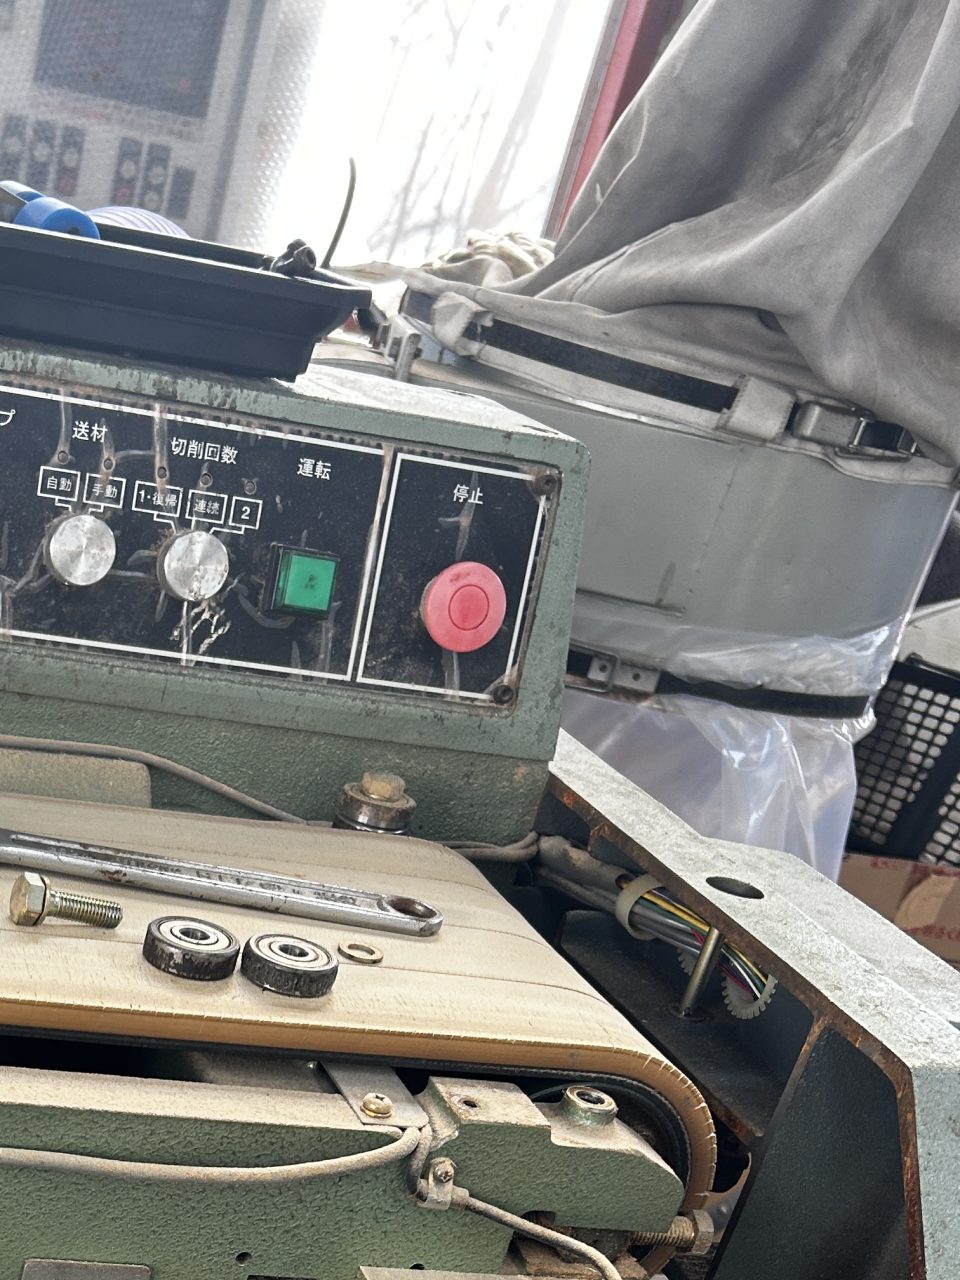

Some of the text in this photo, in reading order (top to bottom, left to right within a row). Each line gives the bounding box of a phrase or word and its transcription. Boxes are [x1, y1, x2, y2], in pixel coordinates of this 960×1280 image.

[72, 420, 108, 443] 送材
[171, 436, 239, 464] 切削回数
[296, 458, 332, 480] 運転
[46, 476, 72, 491] 自動
[92, 483, 118, 498] 手動
[452, 484, 484, 505] 停止
[241, 507, 251, 520] 2
